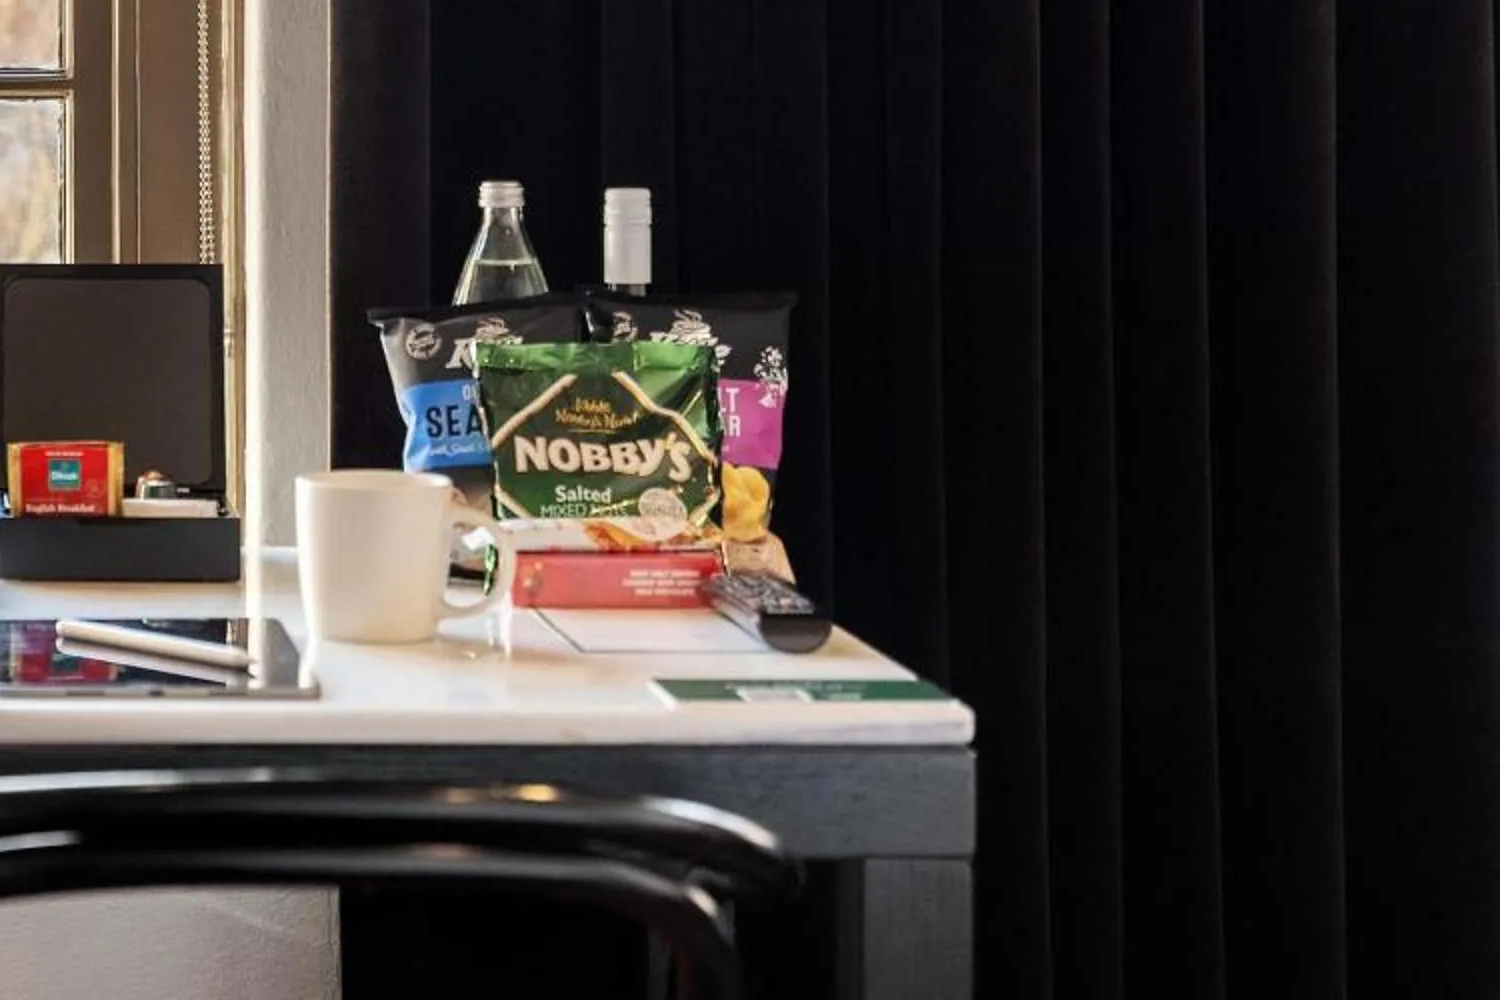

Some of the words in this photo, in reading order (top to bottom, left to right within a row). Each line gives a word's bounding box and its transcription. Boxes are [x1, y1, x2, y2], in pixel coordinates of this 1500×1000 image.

[513, 432, 693, 483] NOBBY'S
[554, 484, 612, 504] Salted
[540, 503, 587, 518] MIXED
